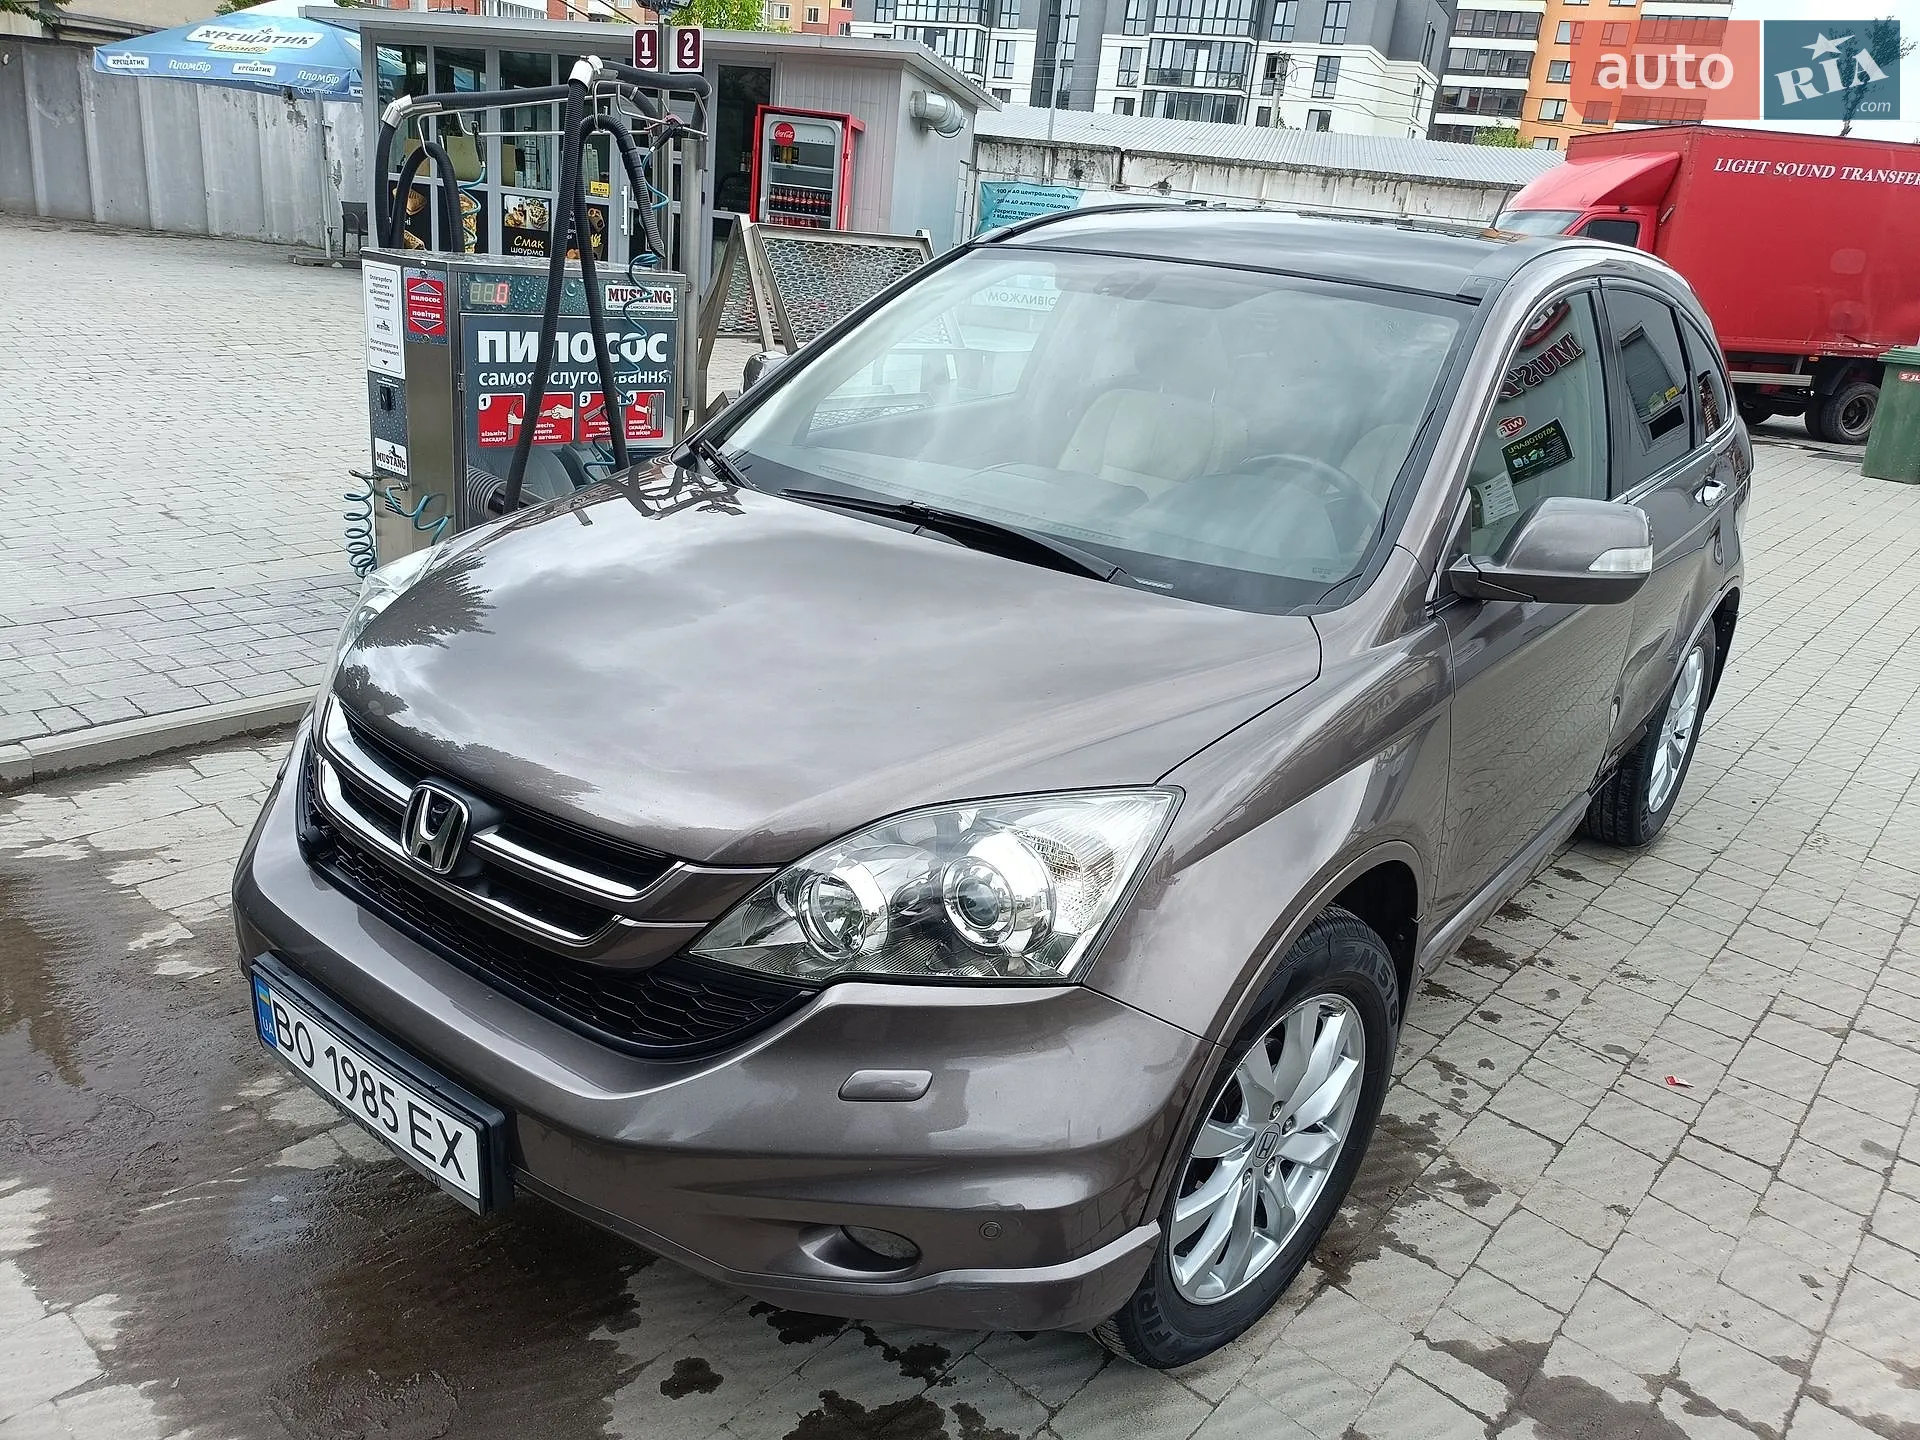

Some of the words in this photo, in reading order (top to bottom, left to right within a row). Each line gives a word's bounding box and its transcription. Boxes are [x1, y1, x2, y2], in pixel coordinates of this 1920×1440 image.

[198, 28, 316, 46] ХРЕЩАТИК
[683, 32, 694, 56] 2
[641, 33, 651, 56] 1
[112, 58, 145, 66] ХРЕЩАТИК
[168, 59, 211, 72] Пломбір
[297, 70, 340, 85] Пломбір
[1713, 157, 1772, 175] LIGHT
[1773, 161, 1836, 179] SOUND
[514, 235, 545, 249] Смак
[510, 247, 544, 257] шаурма
[411, 295, 441, 303] пилосос
[412, 310, 441, 319] повітря
[481, 398, 487, 407] 1
[582, 395, 588, 404] 3
[376, 451, 407, 470] MUSTANG
[262, 1018, 275, 1038] UA
[272, 999, 315, 1069] BO
[324, 1046, 399, 1134] 1985
[407, 1100, 466, 1182] EX
